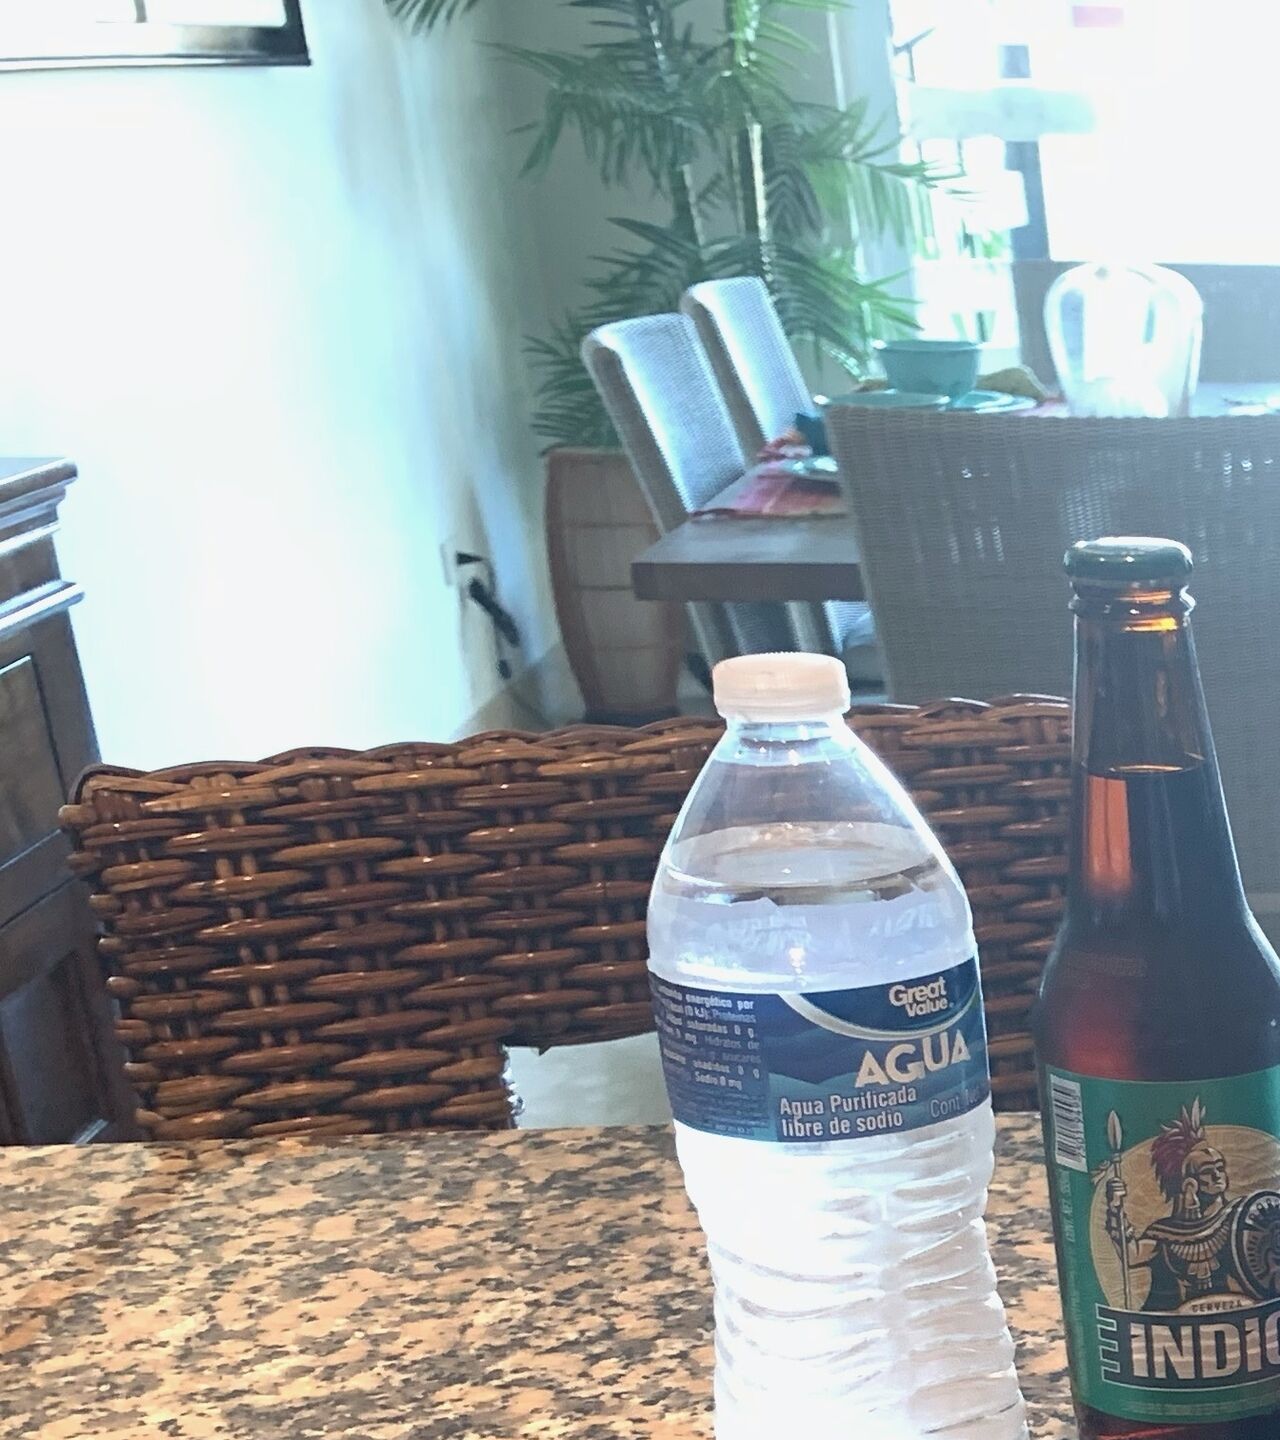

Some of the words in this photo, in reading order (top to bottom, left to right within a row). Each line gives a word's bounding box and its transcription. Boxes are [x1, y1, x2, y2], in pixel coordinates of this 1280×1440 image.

[889, 976, 948, 1007] Great
[855, 1029, 971, 1089] AGUA
[780, 1097, 824, 1120] Agua
[831, 1086, 917, 1113] Purificada
[781, 1115, 824, 1137] libre
[830, 1117, 851, 1134] de
[857, 1110, 903, 1132] sodio
[1191, 1299, 1242, 1313] CERVEZA
